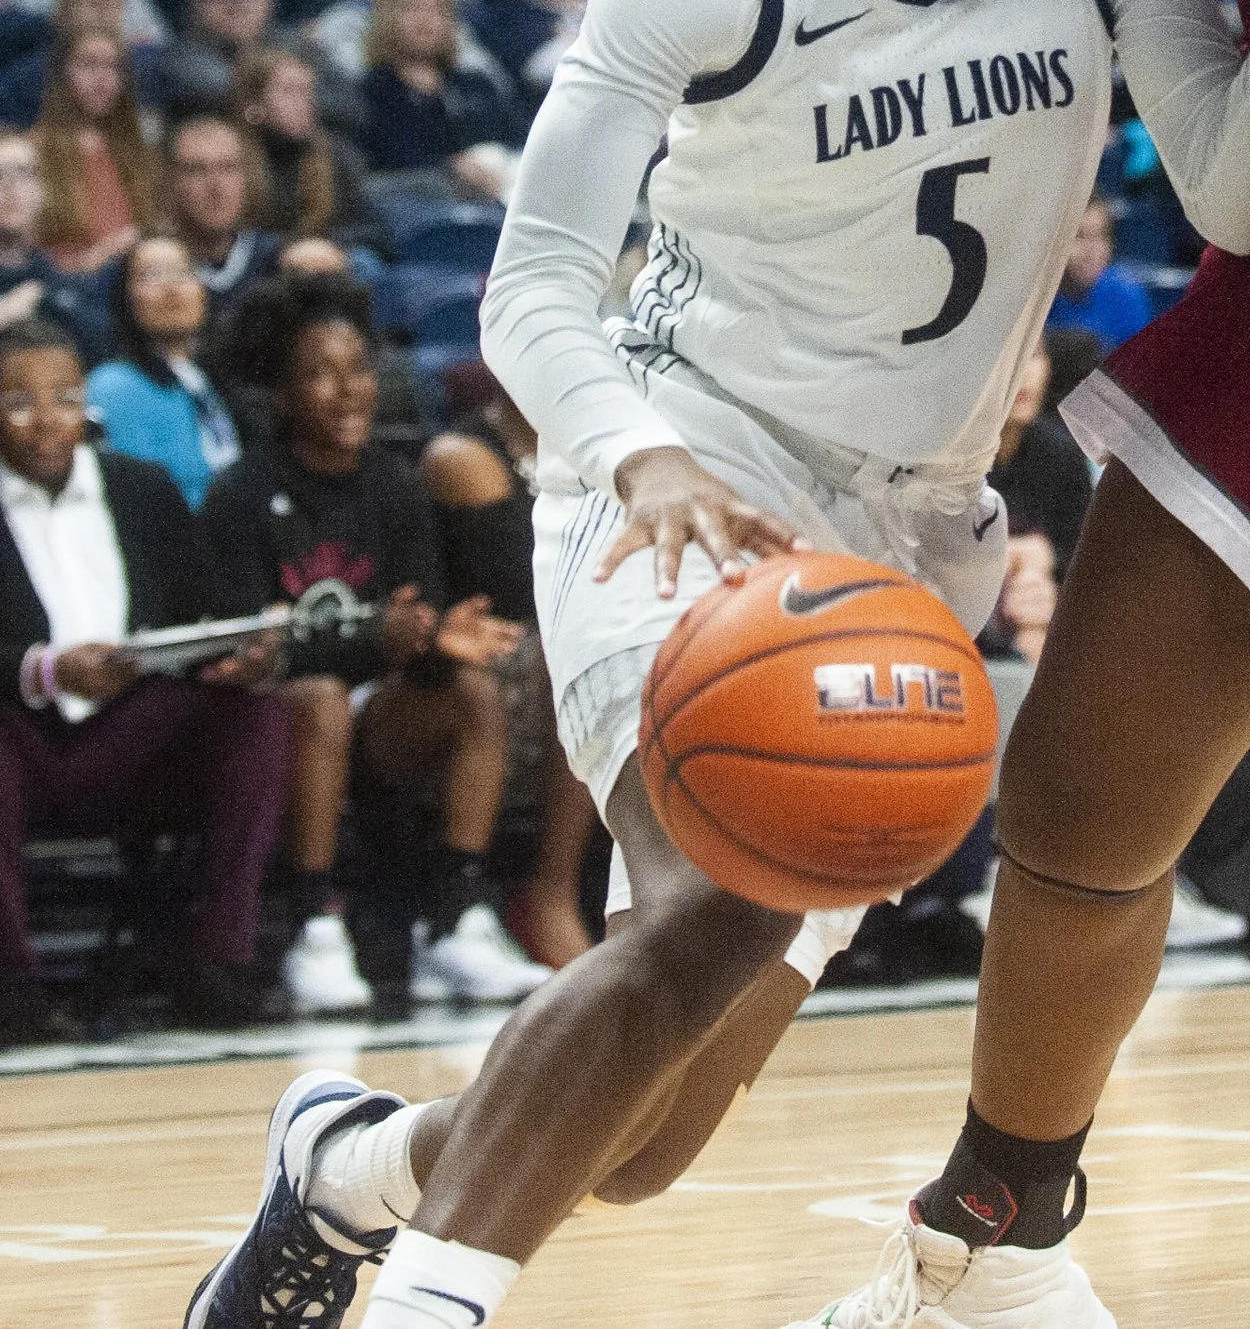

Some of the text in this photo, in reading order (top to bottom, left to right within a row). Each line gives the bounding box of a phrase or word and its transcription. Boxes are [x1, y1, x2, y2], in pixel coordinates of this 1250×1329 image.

[814, 48, 1076, 163] LADY LIONS
[901, 155, 991, 346] 5
